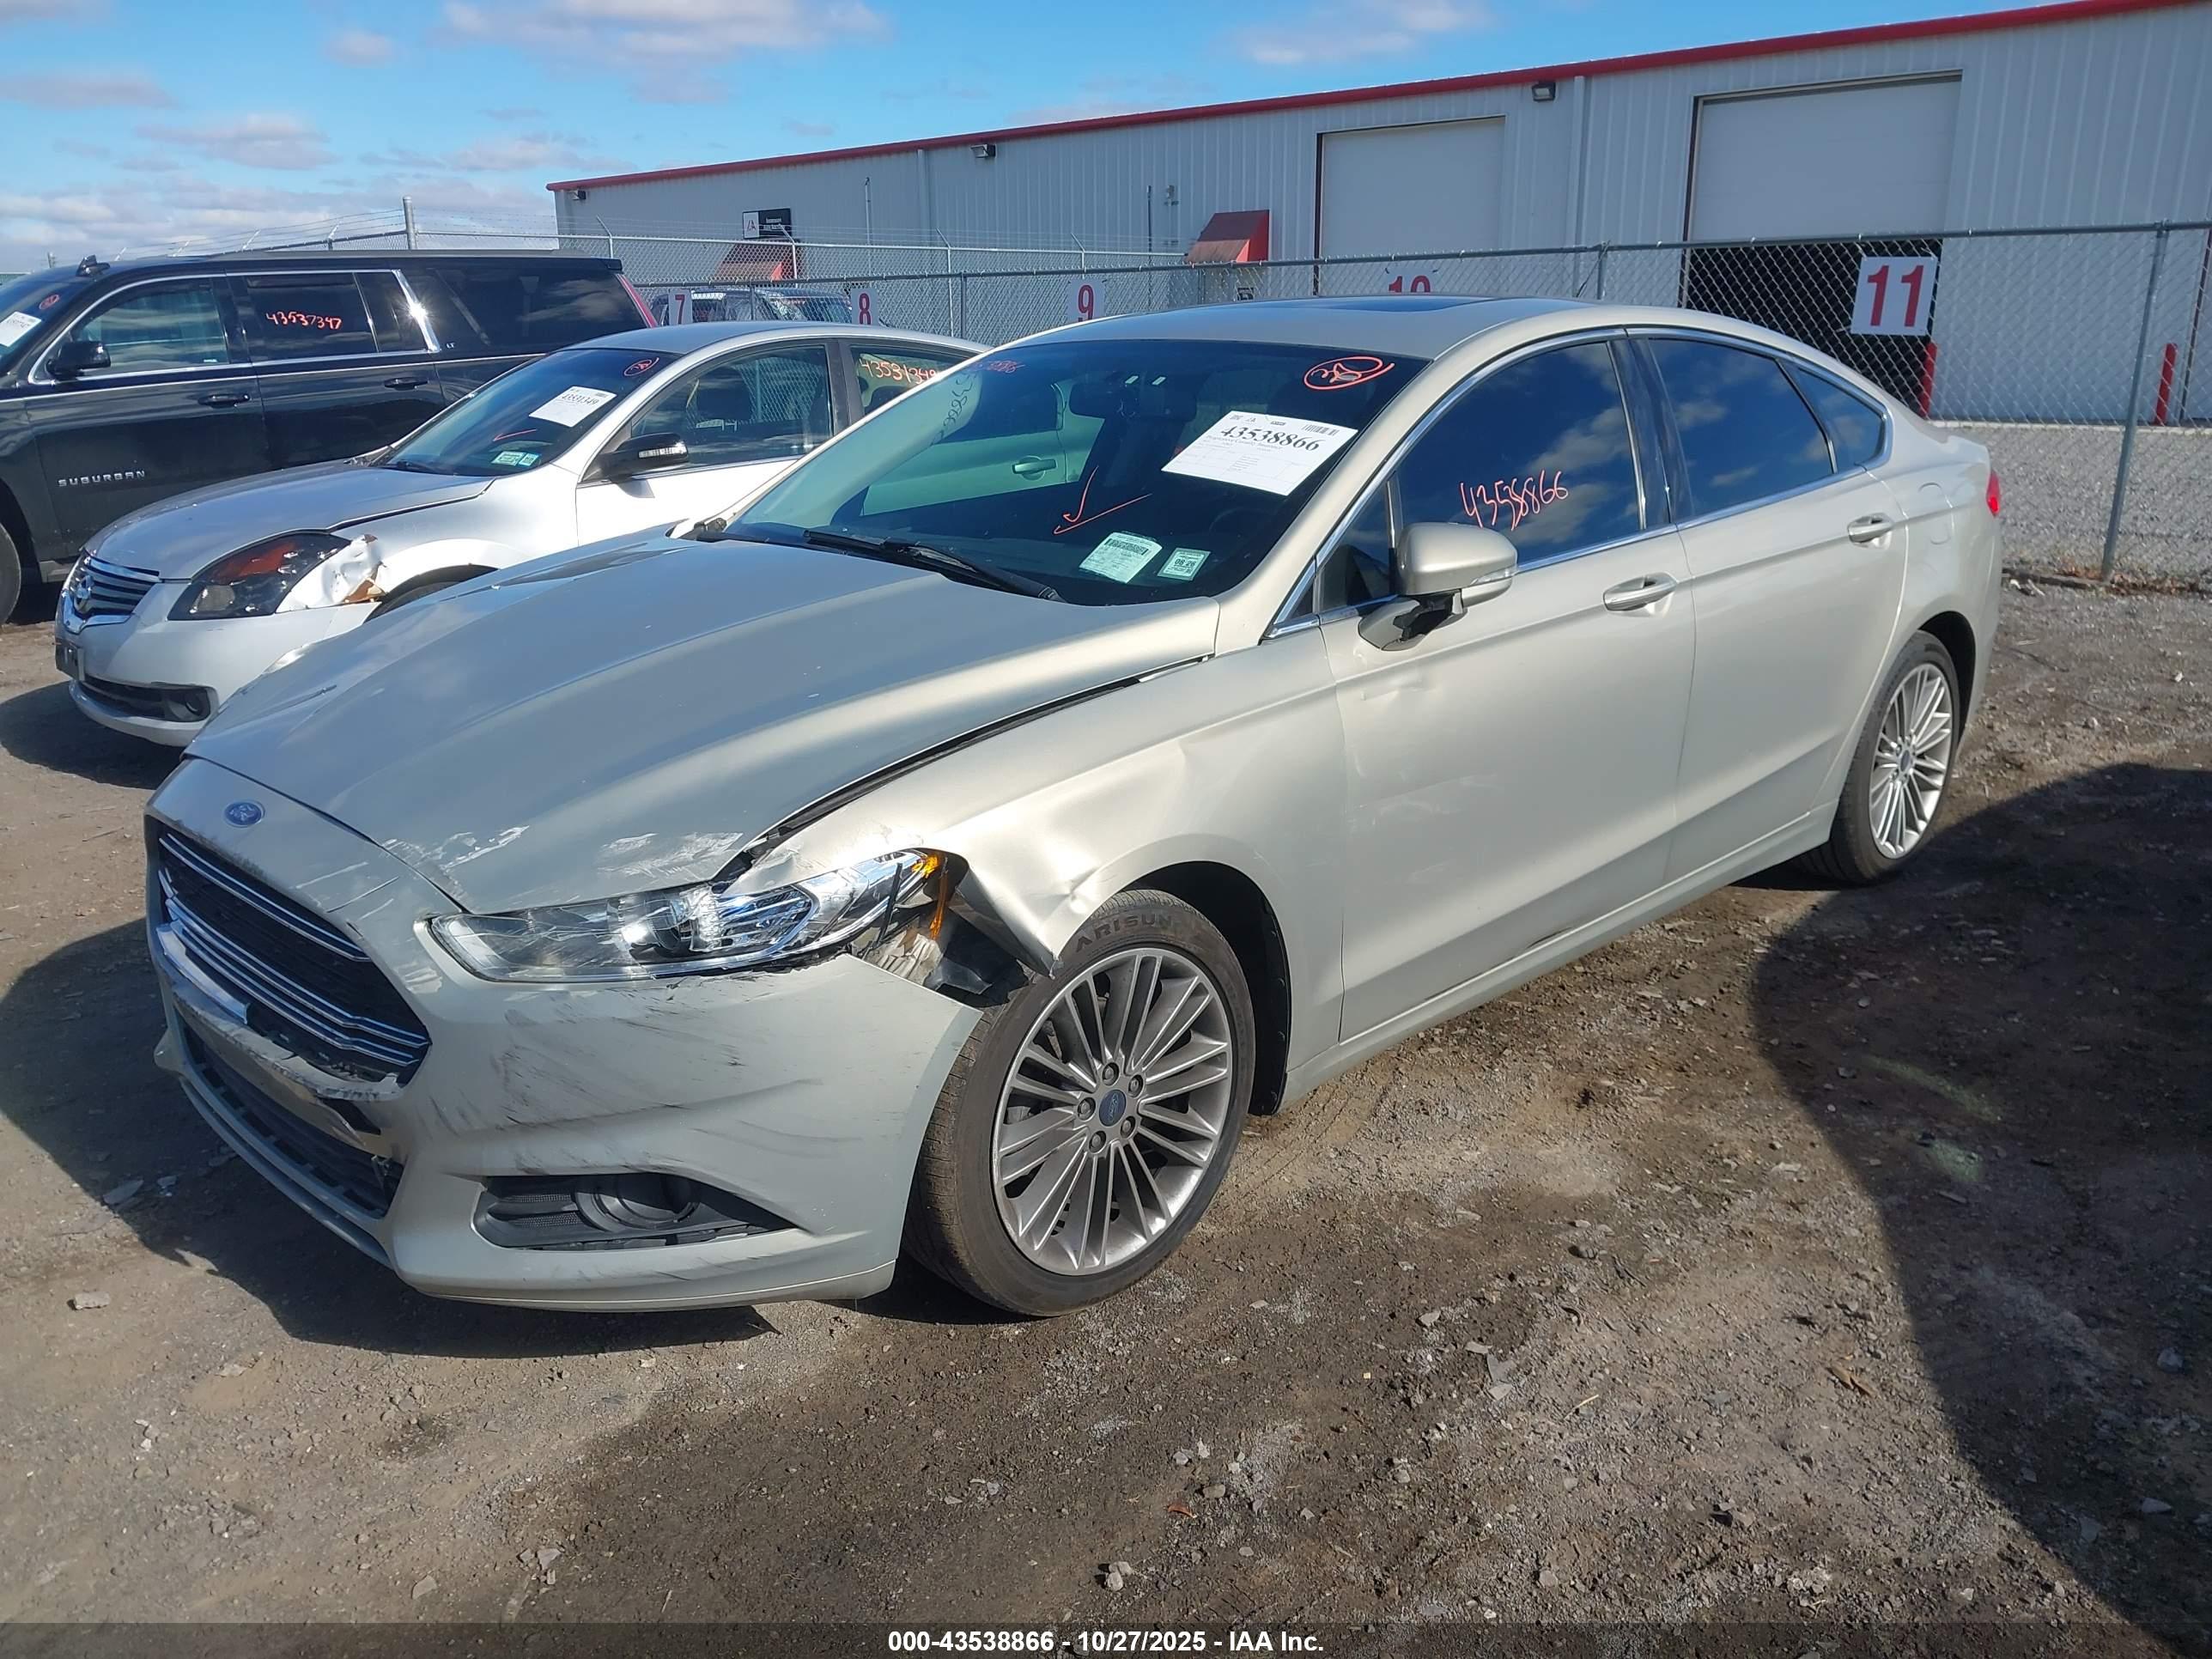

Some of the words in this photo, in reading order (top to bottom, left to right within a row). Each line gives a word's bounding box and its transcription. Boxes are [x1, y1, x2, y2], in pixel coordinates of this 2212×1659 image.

[675, 295, 685, 325] 7
[859, 293, 872, 325] 8
[1078, 284, 1094, 323] 9
[1867, 264, 1923, 326] 11
[265, 311, 342, 329] 43537347
[1220, 425, 1326, 451] 43538866
[58, 470, 145, 487] SUBURBAN
[1076, 913, 1174, 953] ARISUN
